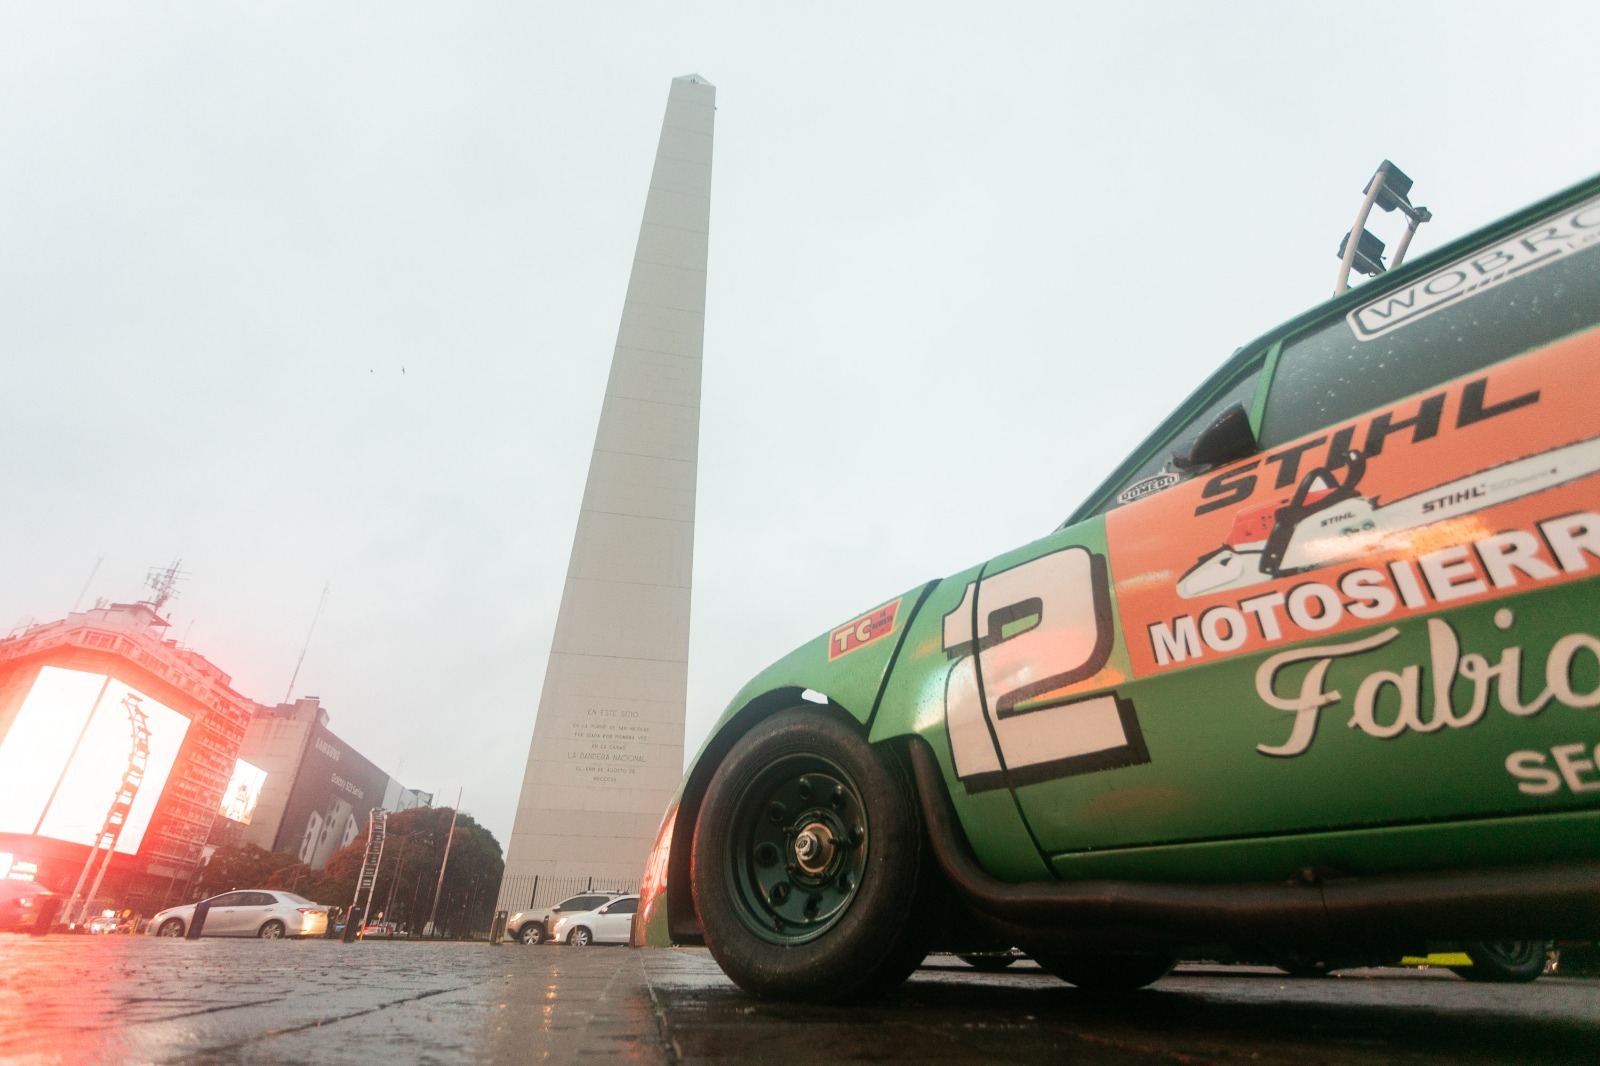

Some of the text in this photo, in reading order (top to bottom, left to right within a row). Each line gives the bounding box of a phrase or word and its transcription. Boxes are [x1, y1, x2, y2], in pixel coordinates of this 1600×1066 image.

[1194, 378, 1541, 517] STIHL
[1422, 486, 1486, 514] STIHL
[1320, 511, 1356, 528] STIHL
[833, 617, 872, 653] TC
[600, 709, 617, 717] ESTE
[621, 710, 639, 718] SITIO
[579, 752, 610, 761] BANDERA
[612, 754, 647, 763] NACIONAL
[1504, 742, 1600, 795] SE
